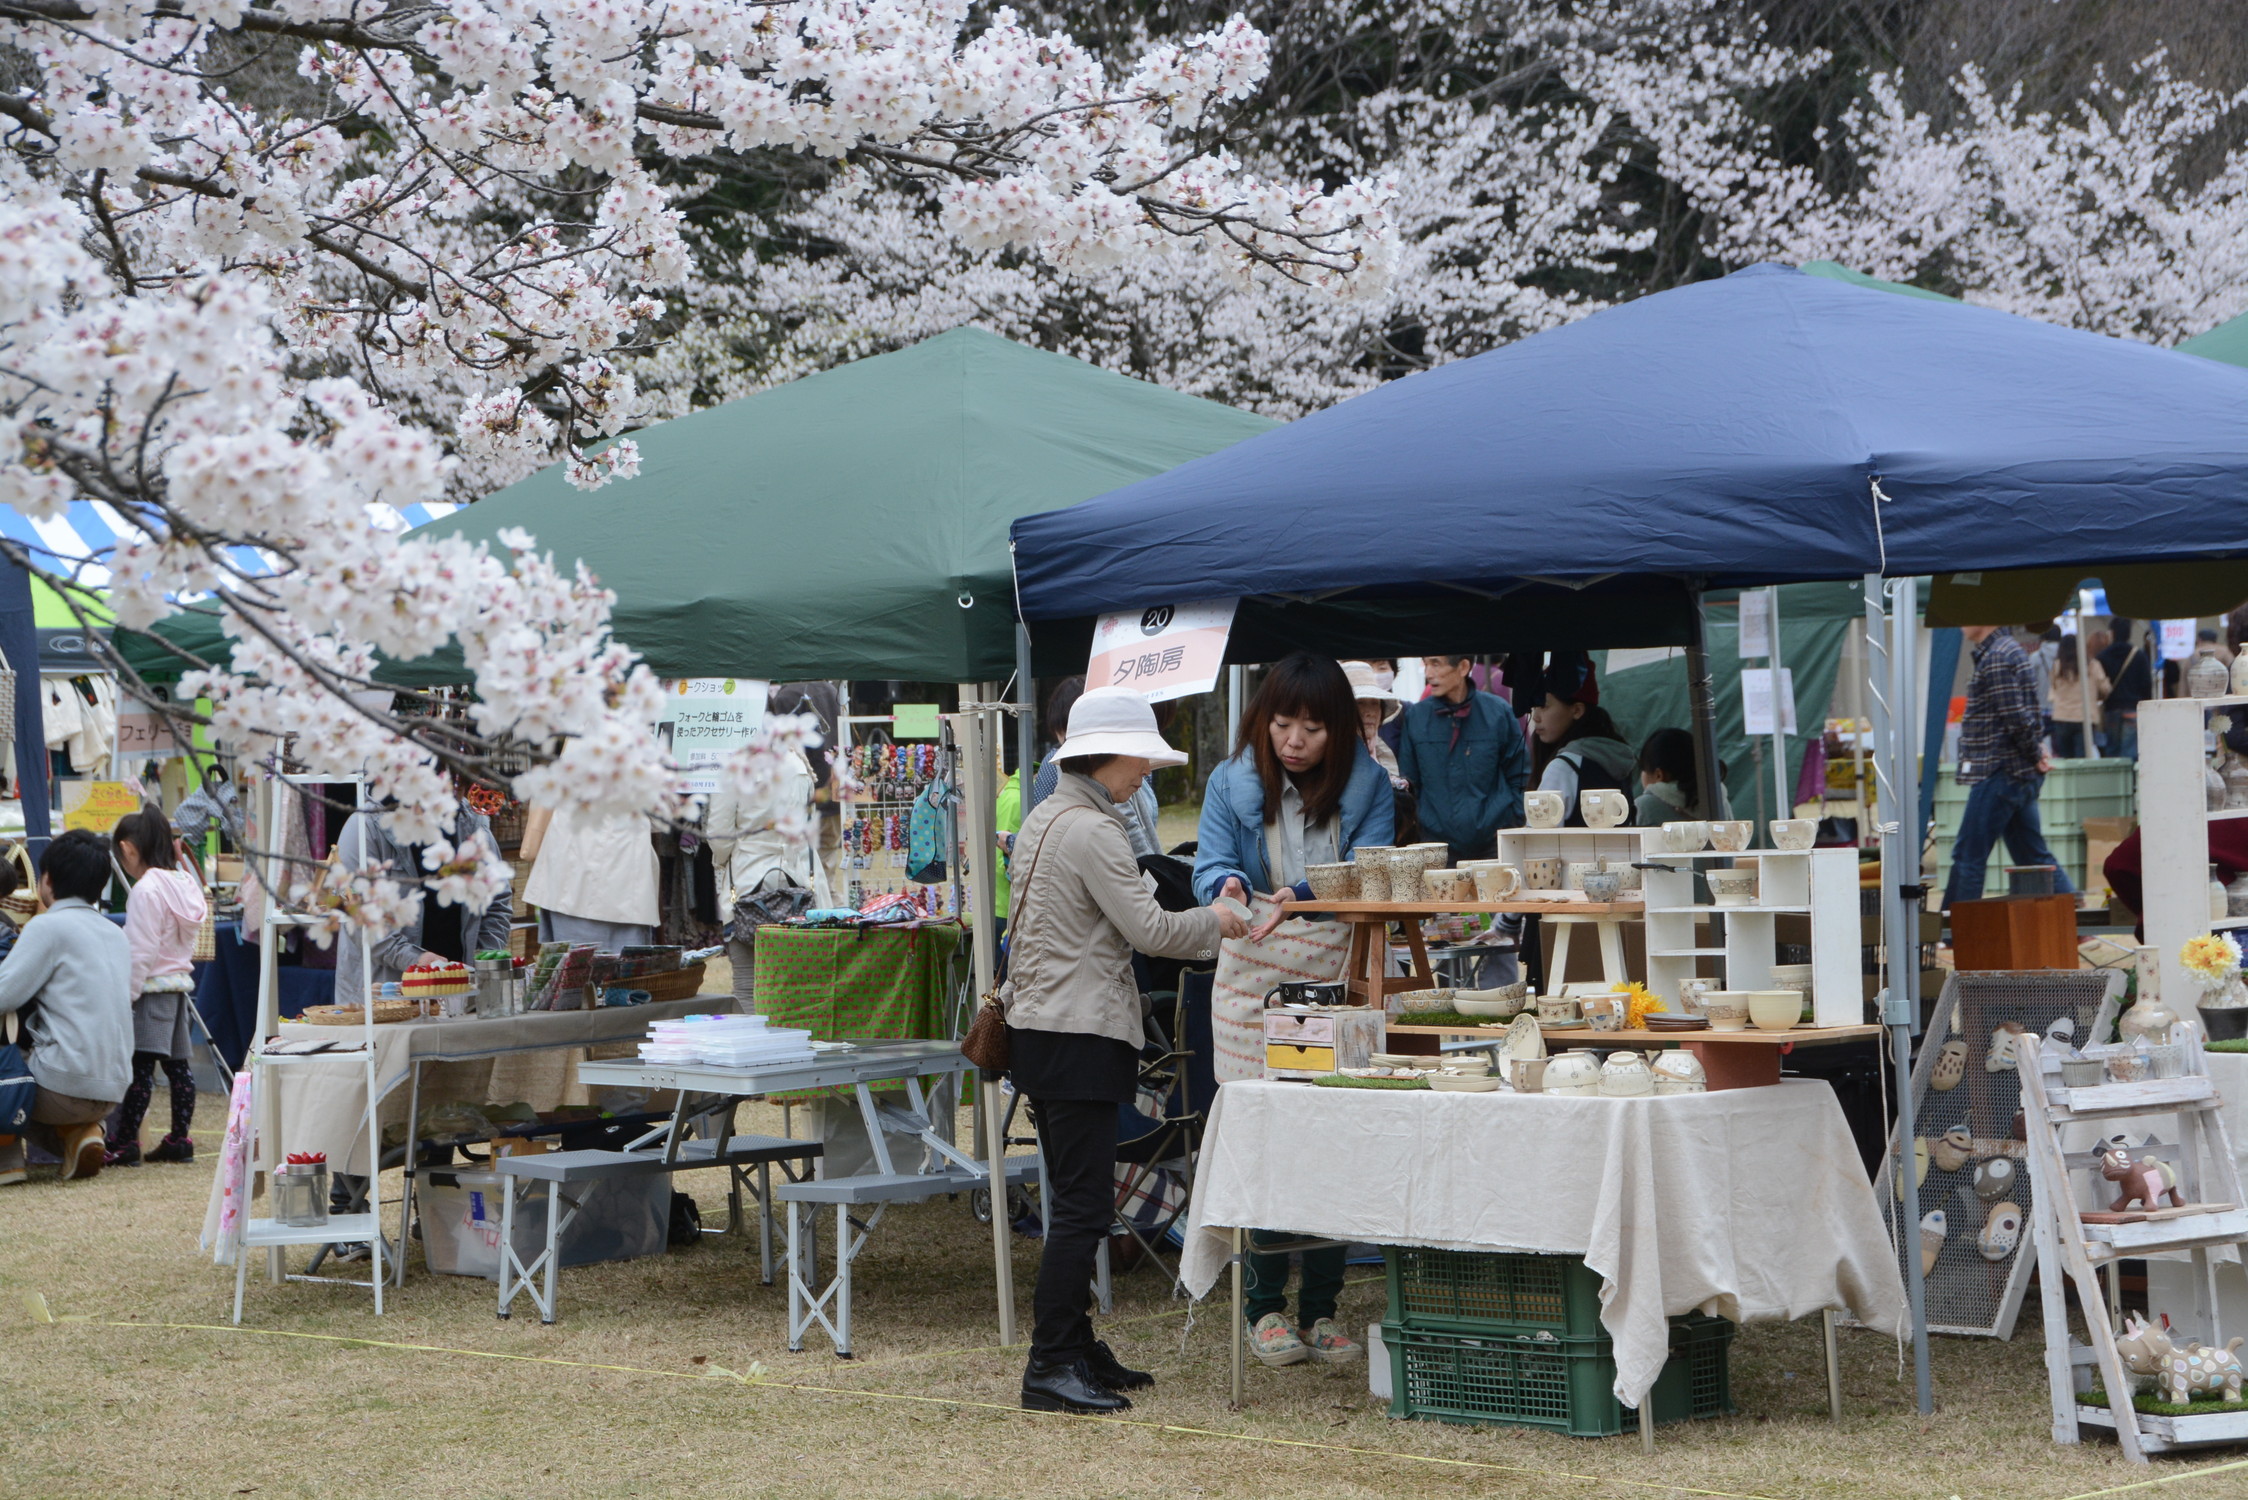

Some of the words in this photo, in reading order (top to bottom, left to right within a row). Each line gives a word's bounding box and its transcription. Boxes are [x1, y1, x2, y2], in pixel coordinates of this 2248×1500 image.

[1145, 607, 1169, 631] 20
[1113, 645, 1186, 685] 夕陶房
[679, 682, 734, 693] ワークショップ
[678, 711, 743, 723] フォークと輪ゴムを
[676, 726, 757, 738] 使ったアクセサリー作り
